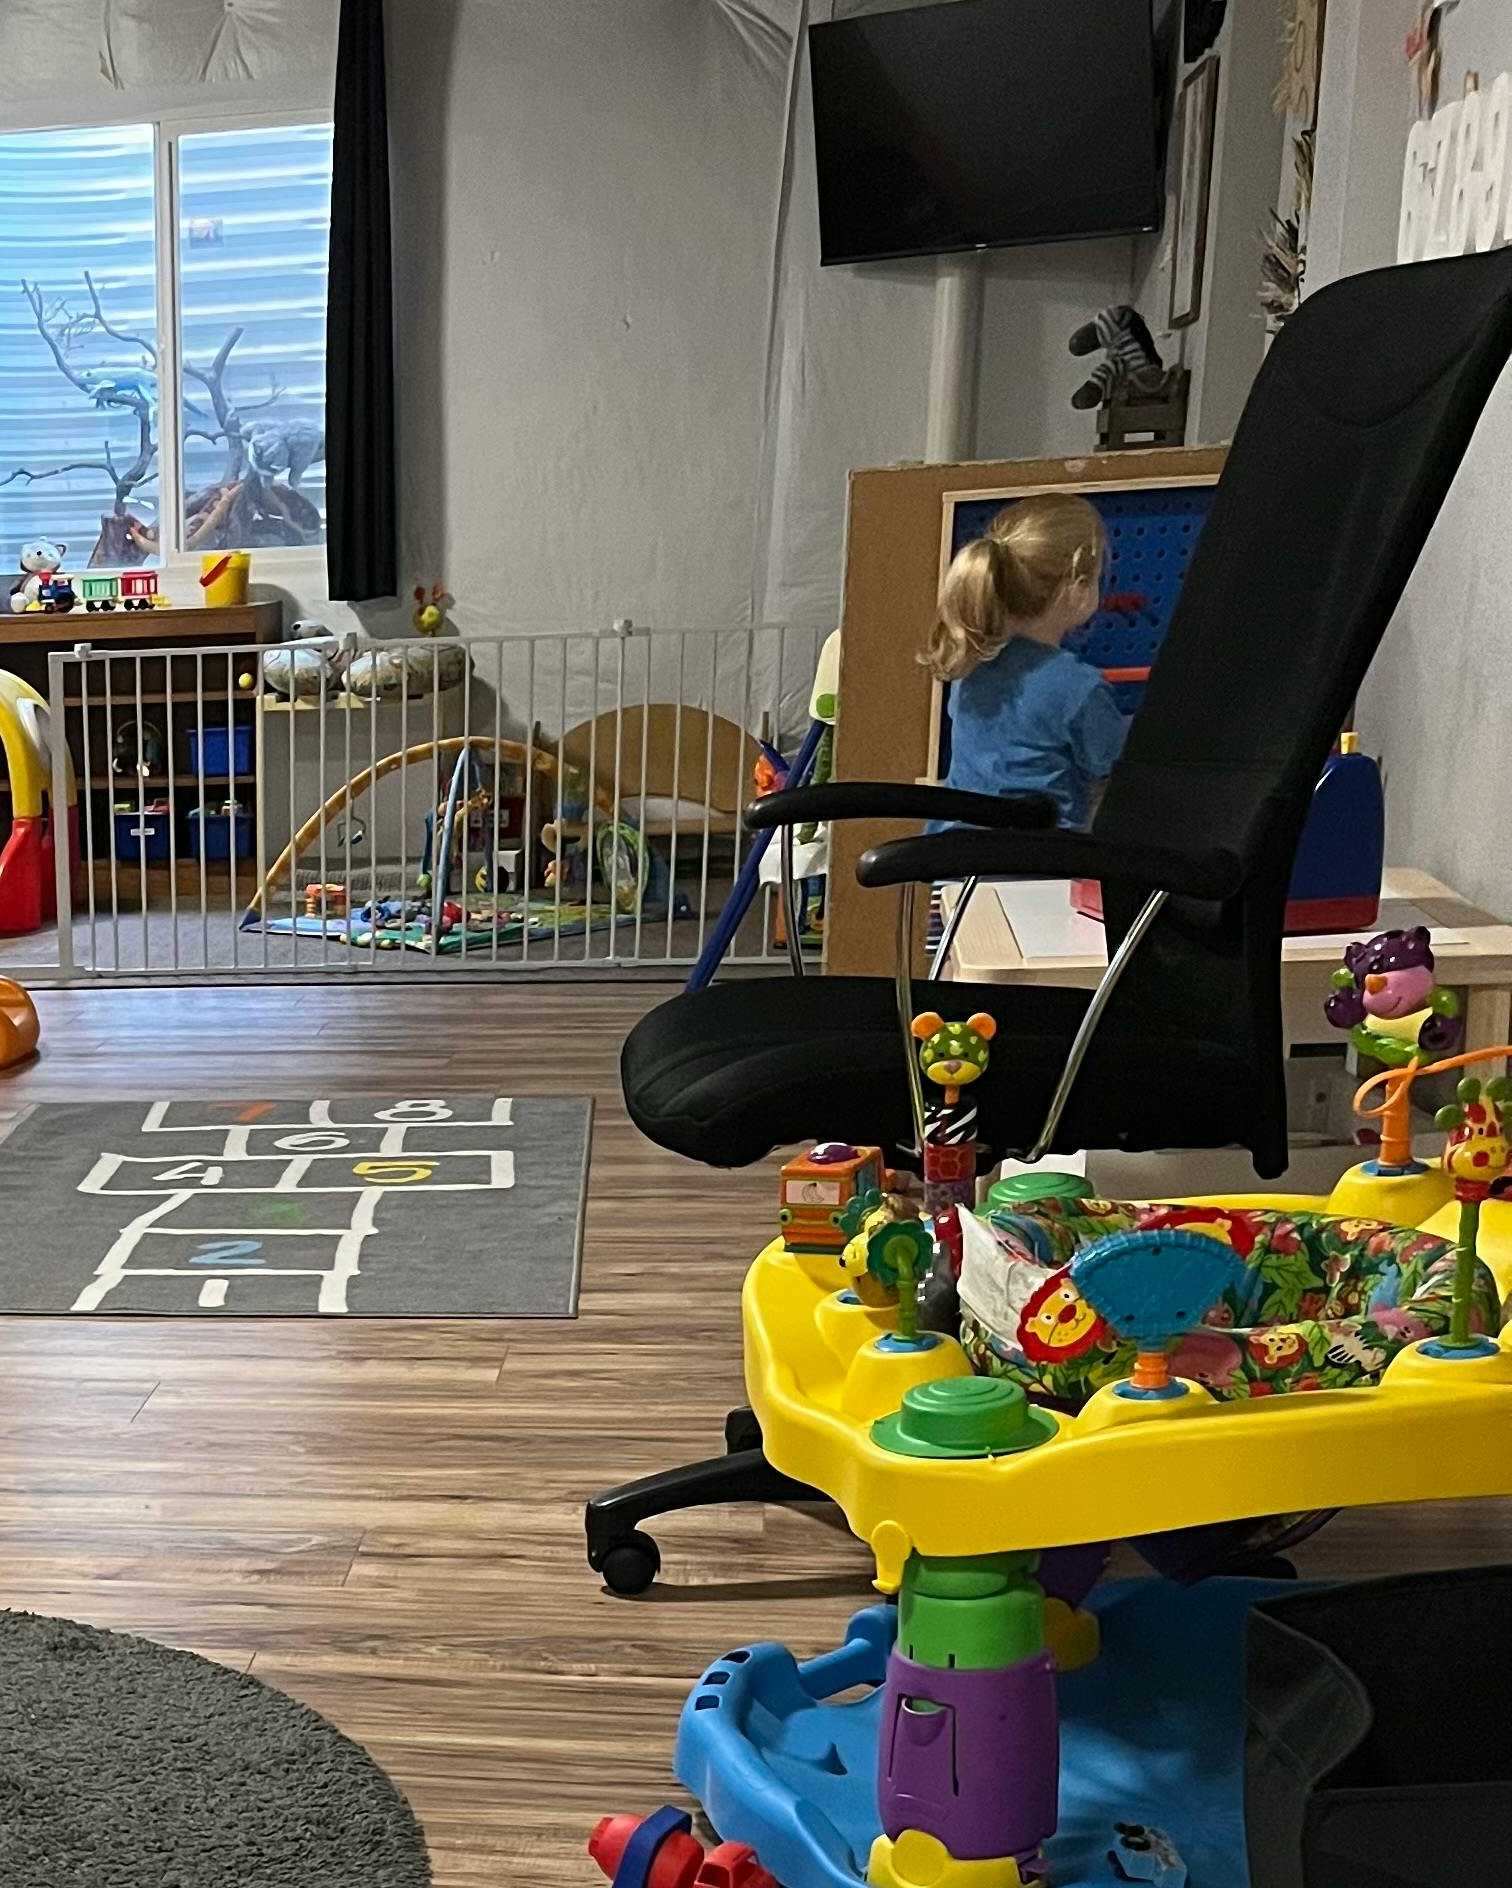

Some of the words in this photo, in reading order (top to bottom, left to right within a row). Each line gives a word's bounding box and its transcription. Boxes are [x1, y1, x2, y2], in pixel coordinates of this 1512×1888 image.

[210, 1101, 275, 1124] 7
[374, 1099, 453, 1121] 8
[274, 1131, 350, 1150] 6
[153, 1161, 223, 1186] 4
[353, 1161, 439, 1183] 5
[189, 1240, 266, 1265] 2
